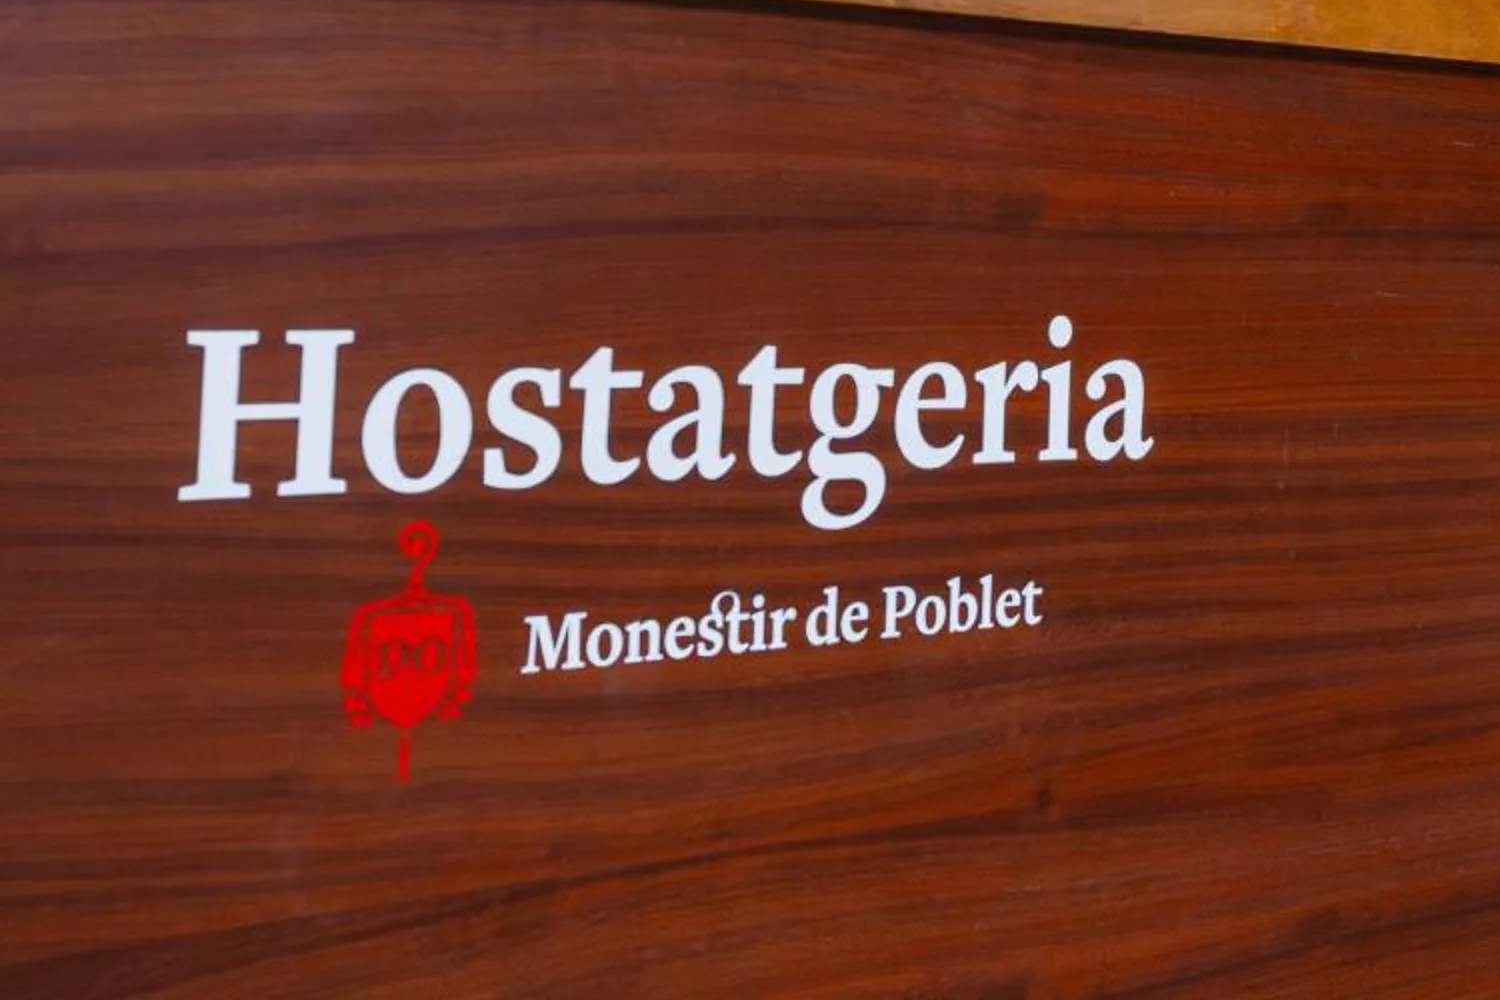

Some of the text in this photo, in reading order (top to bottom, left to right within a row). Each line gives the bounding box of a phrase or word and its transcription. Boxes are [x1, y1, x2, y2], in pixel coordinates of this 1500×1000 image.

[177, 315, 1154, 530] Hostatgeria
[520, 574, 1043, 674] Monestir de Poblet
